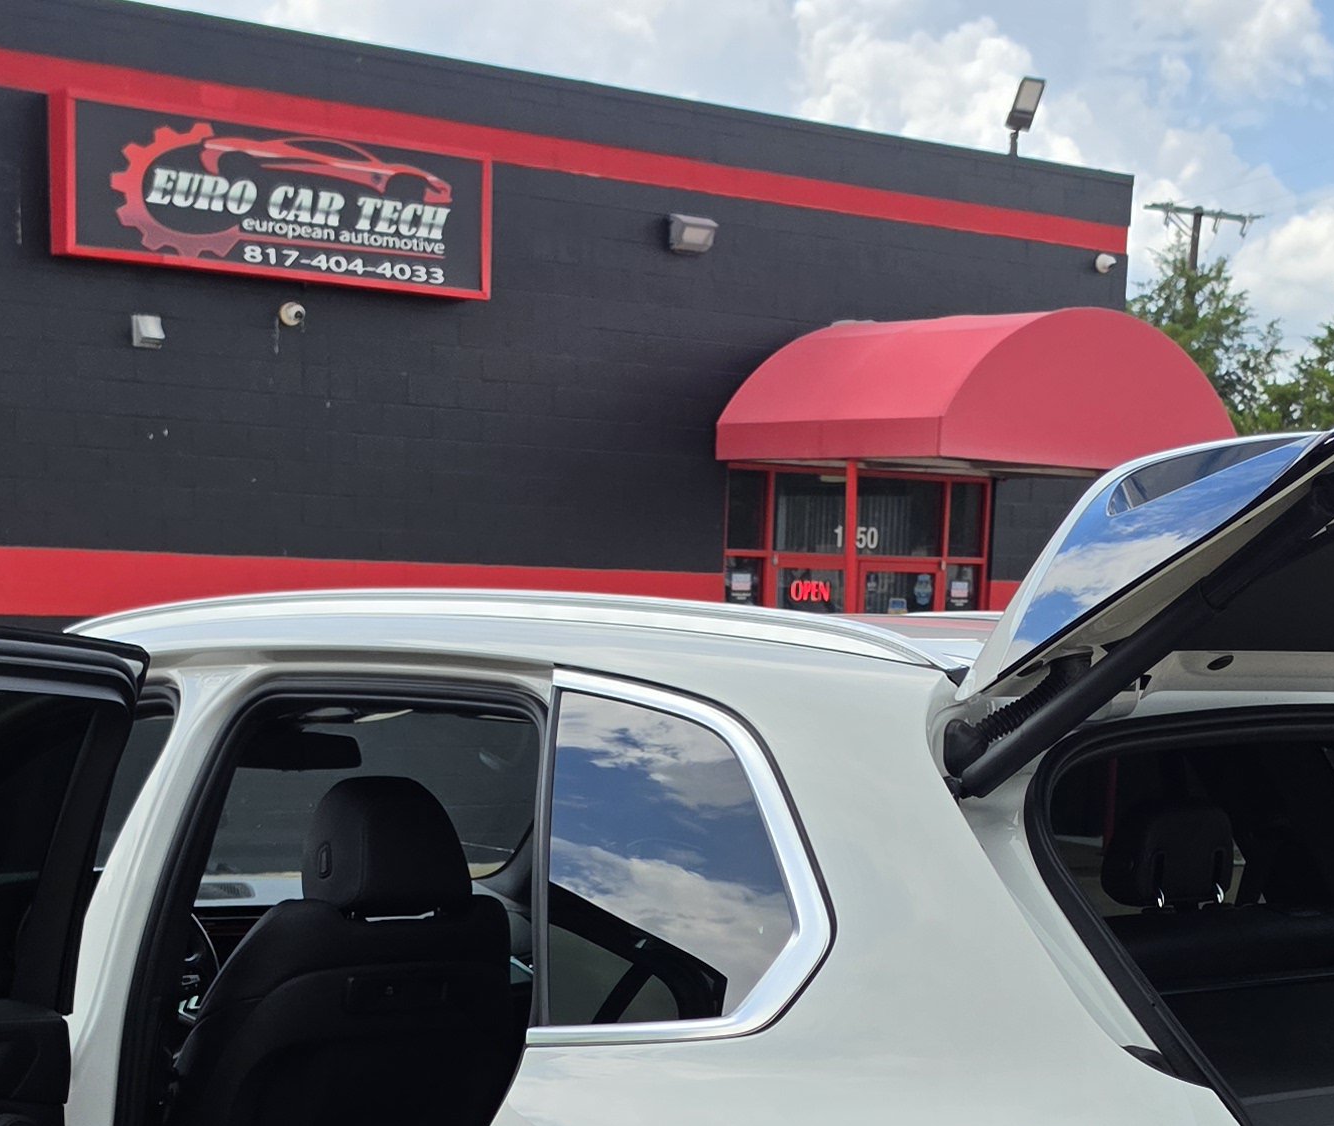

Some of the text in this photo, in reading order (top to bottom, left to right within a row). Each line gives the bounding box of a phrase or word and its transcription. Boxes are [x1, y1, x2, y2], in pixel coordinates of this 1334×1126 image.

[145, 168, 451, 239] EURO CAR TECH
[242, 217, 446, 255] european automotive
[243, 245, 445, 285] 817-404-4033
[834, 525, 879, 549] 150
[790, 579, 831, 602] OPEN
